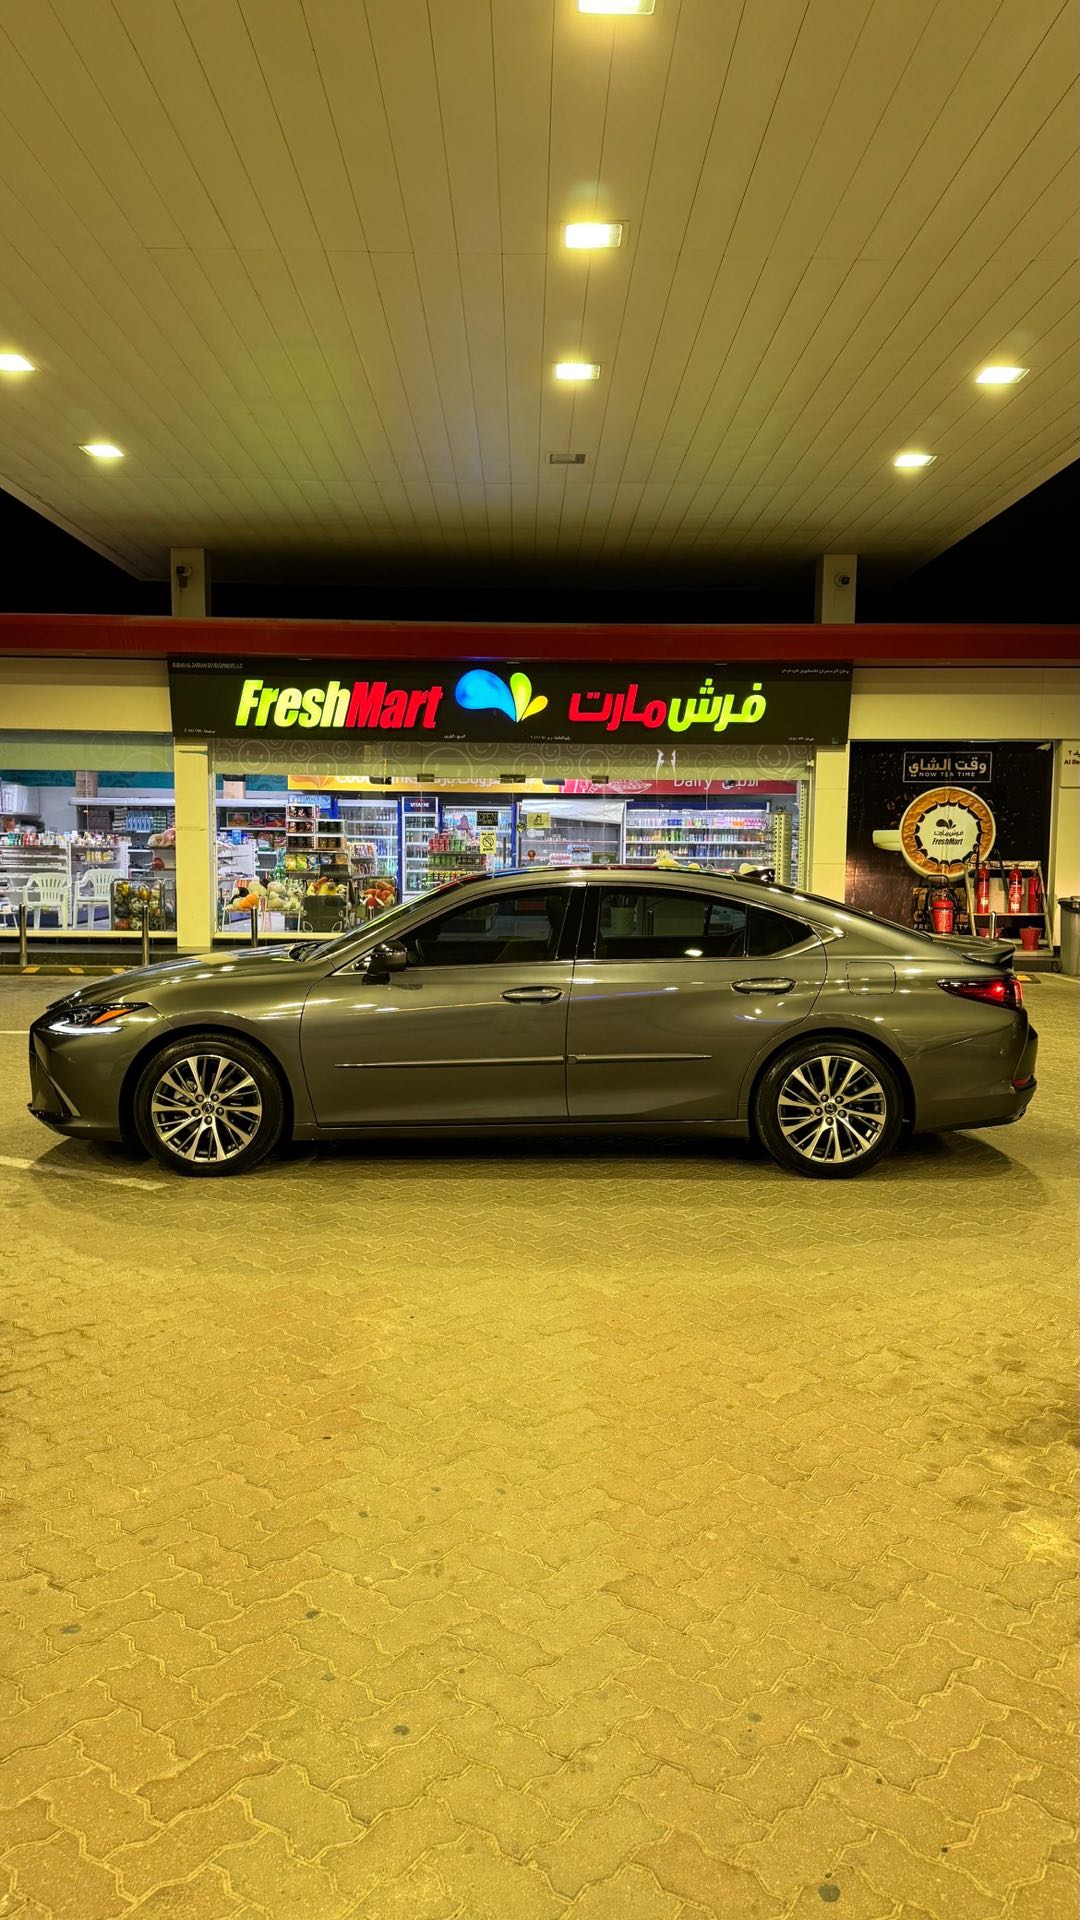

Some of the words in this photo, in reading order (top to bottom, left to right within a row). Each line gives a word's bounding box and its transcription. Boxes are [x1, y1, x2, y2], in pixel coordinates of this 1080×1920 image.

[235, 679, 443, 729] FreshMart
[568, 683, 667, 731] مارت
[667, 678, 767, 732] فرش
[909, 757, 951, 778] الشاي
[955, 757, 986, 774] وقت
